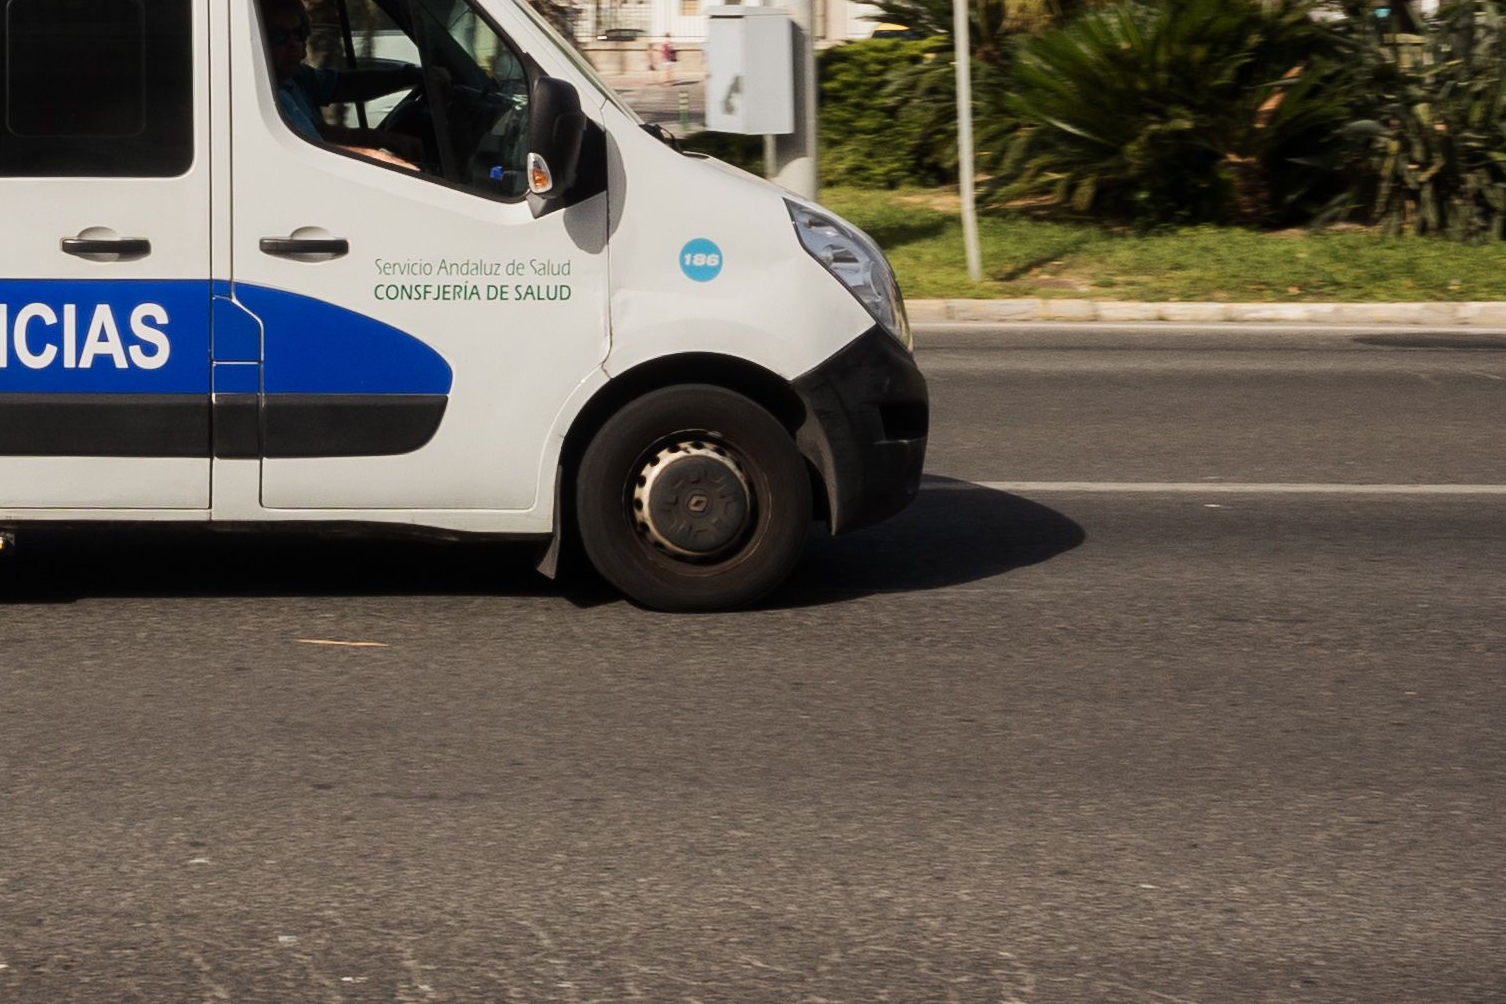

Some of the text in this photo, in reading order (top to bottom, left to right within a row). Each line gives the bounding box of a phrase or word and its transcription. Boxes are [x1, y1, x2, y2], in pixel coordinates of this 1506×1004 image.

[374, 258, 571, 277] Servicio Andaluz de Salud
[685, 253, 719, 266] 186
[486, 284, 510, 301] DE
[514, 284, 572, 302] SALUD
